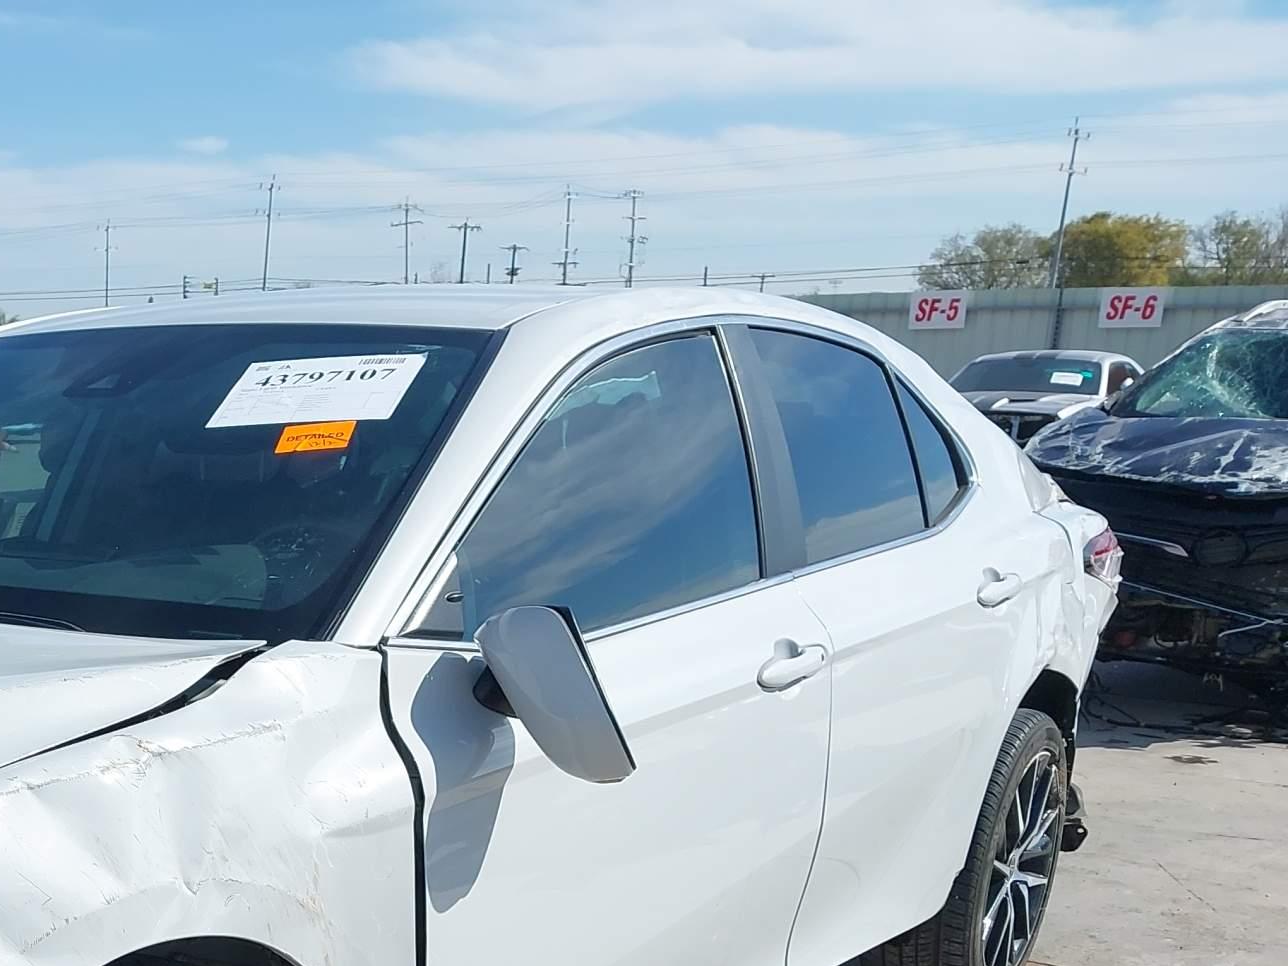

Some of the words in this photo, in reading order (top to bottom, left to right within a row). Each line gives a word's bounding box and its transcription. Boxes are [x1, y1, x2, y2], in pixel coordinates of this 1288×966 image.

[915, 298, 961, 322] SF-5
[1106, 295, 1158, 320] SF-6
[255, 368, 397, 387] 43797107
